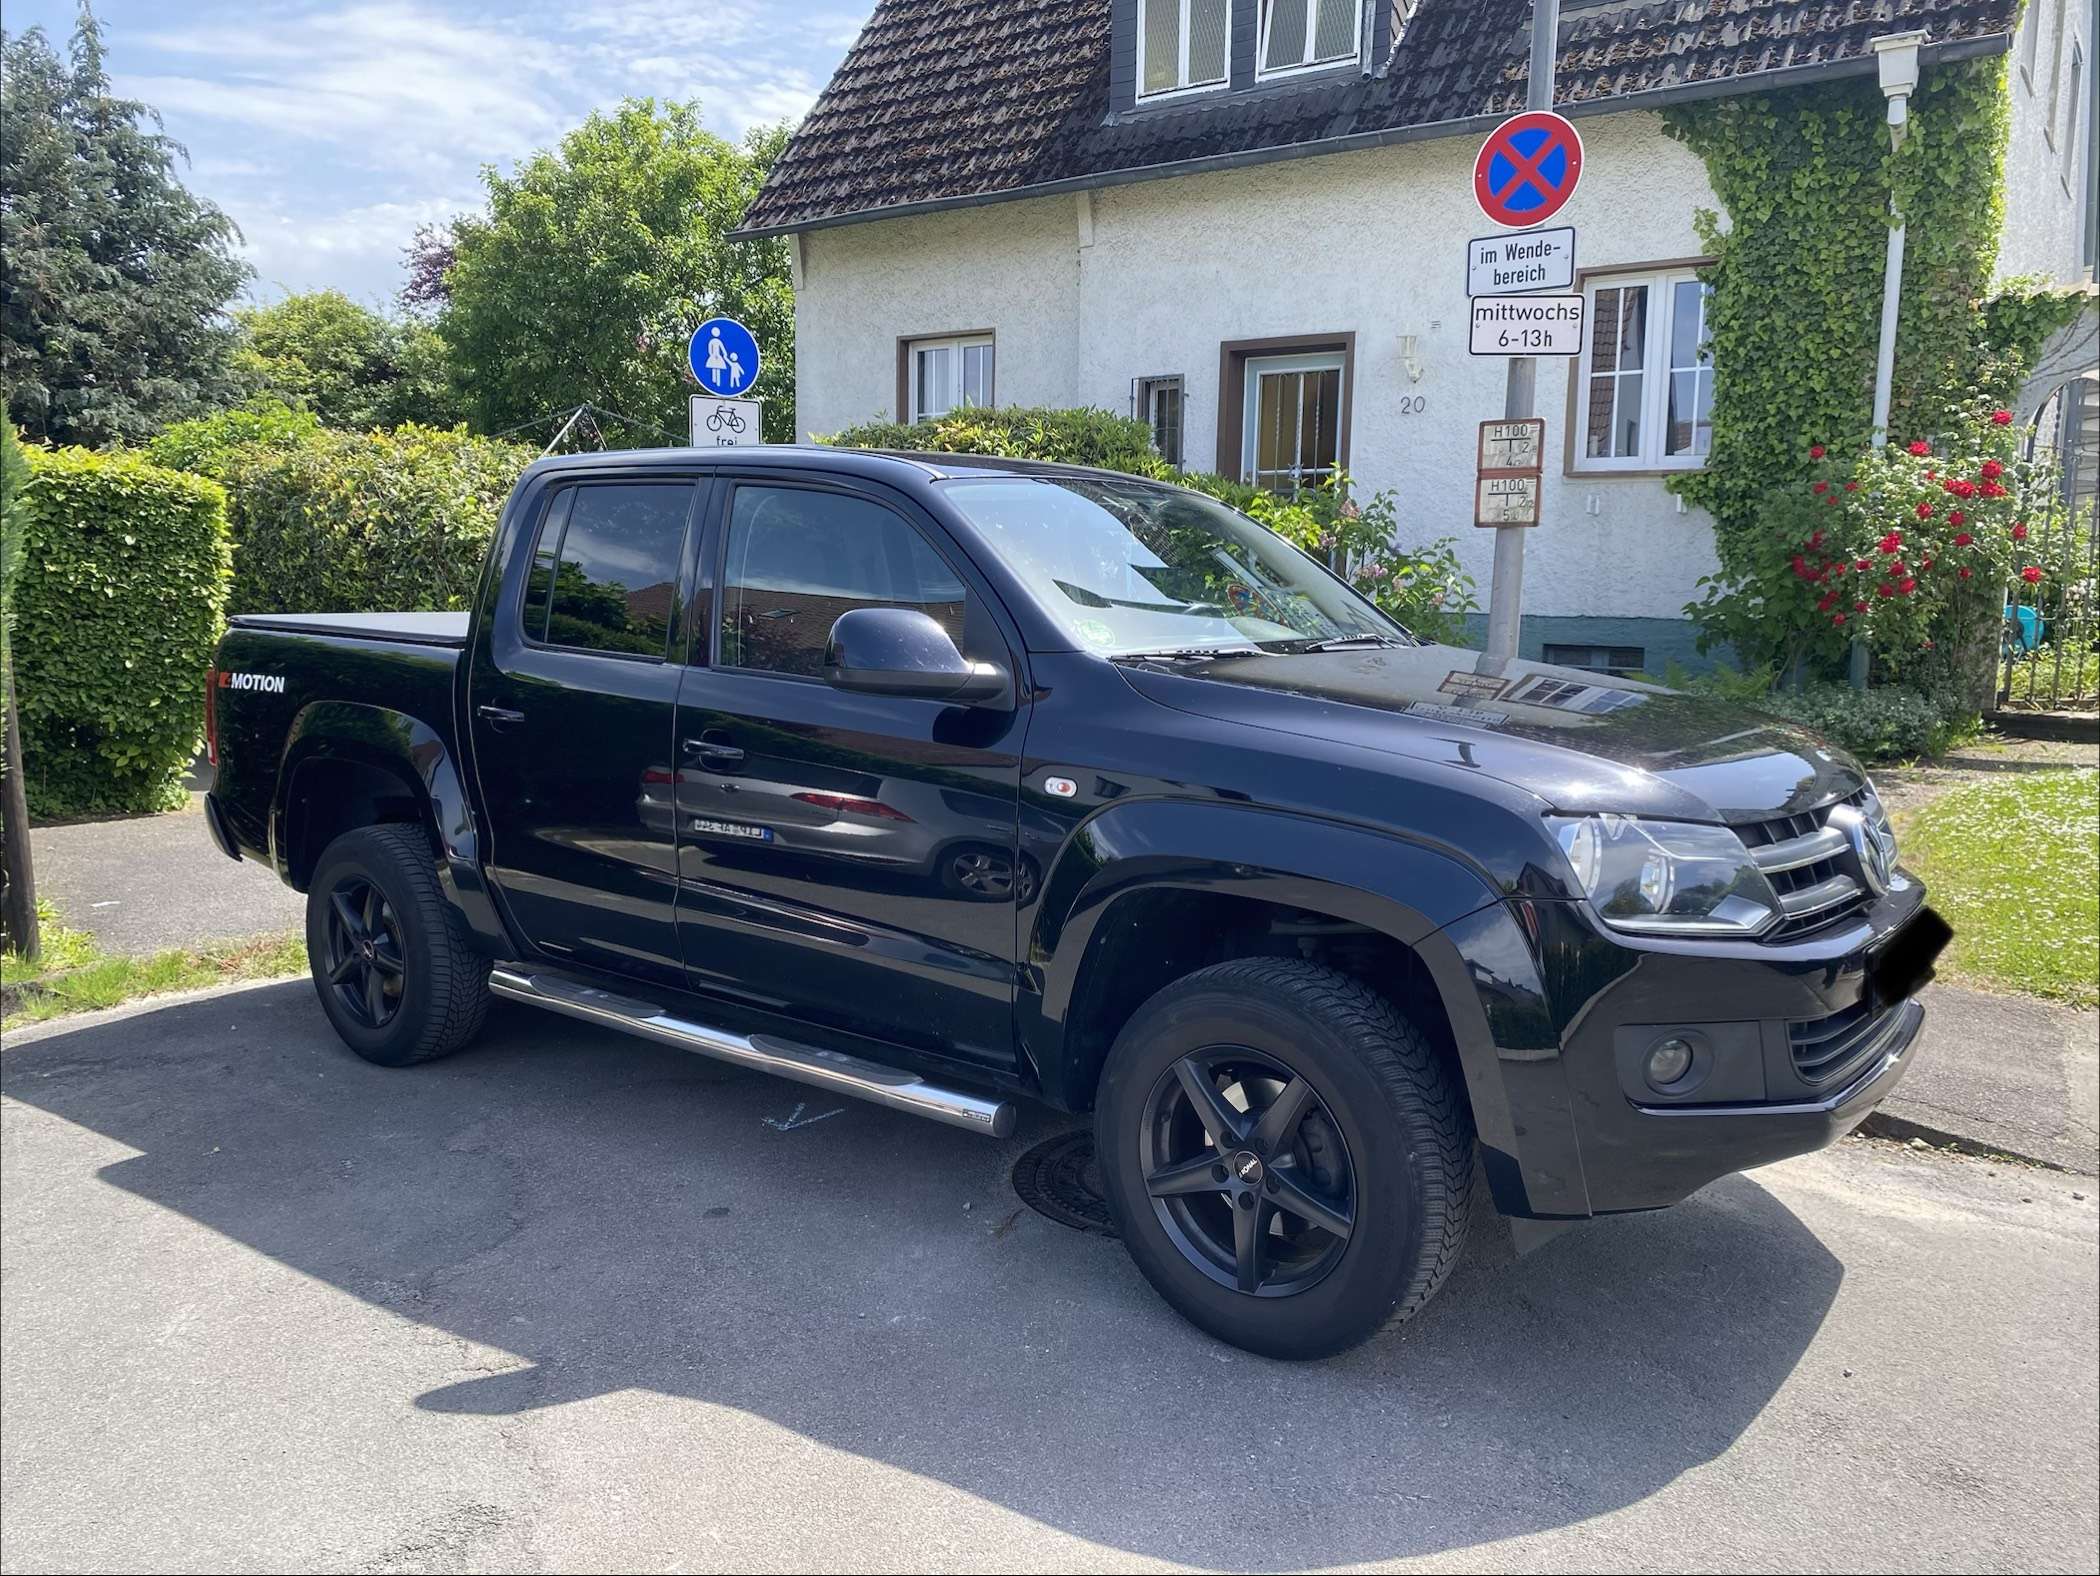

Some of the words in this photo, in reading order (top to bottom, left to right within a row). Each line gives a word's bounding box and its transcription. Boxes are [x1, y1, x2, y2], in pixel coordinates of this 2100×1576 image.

[1480, 247, 1497, 264] im
[1505, 239, 1561, 261] Wende-
[1493, 263, 1546, 286] bereich
[1475, 303, 1580, 321] mittwochs
[1498, 329, 1552, 347] 6-13h
[1400, 395, 1425, 414] 20
